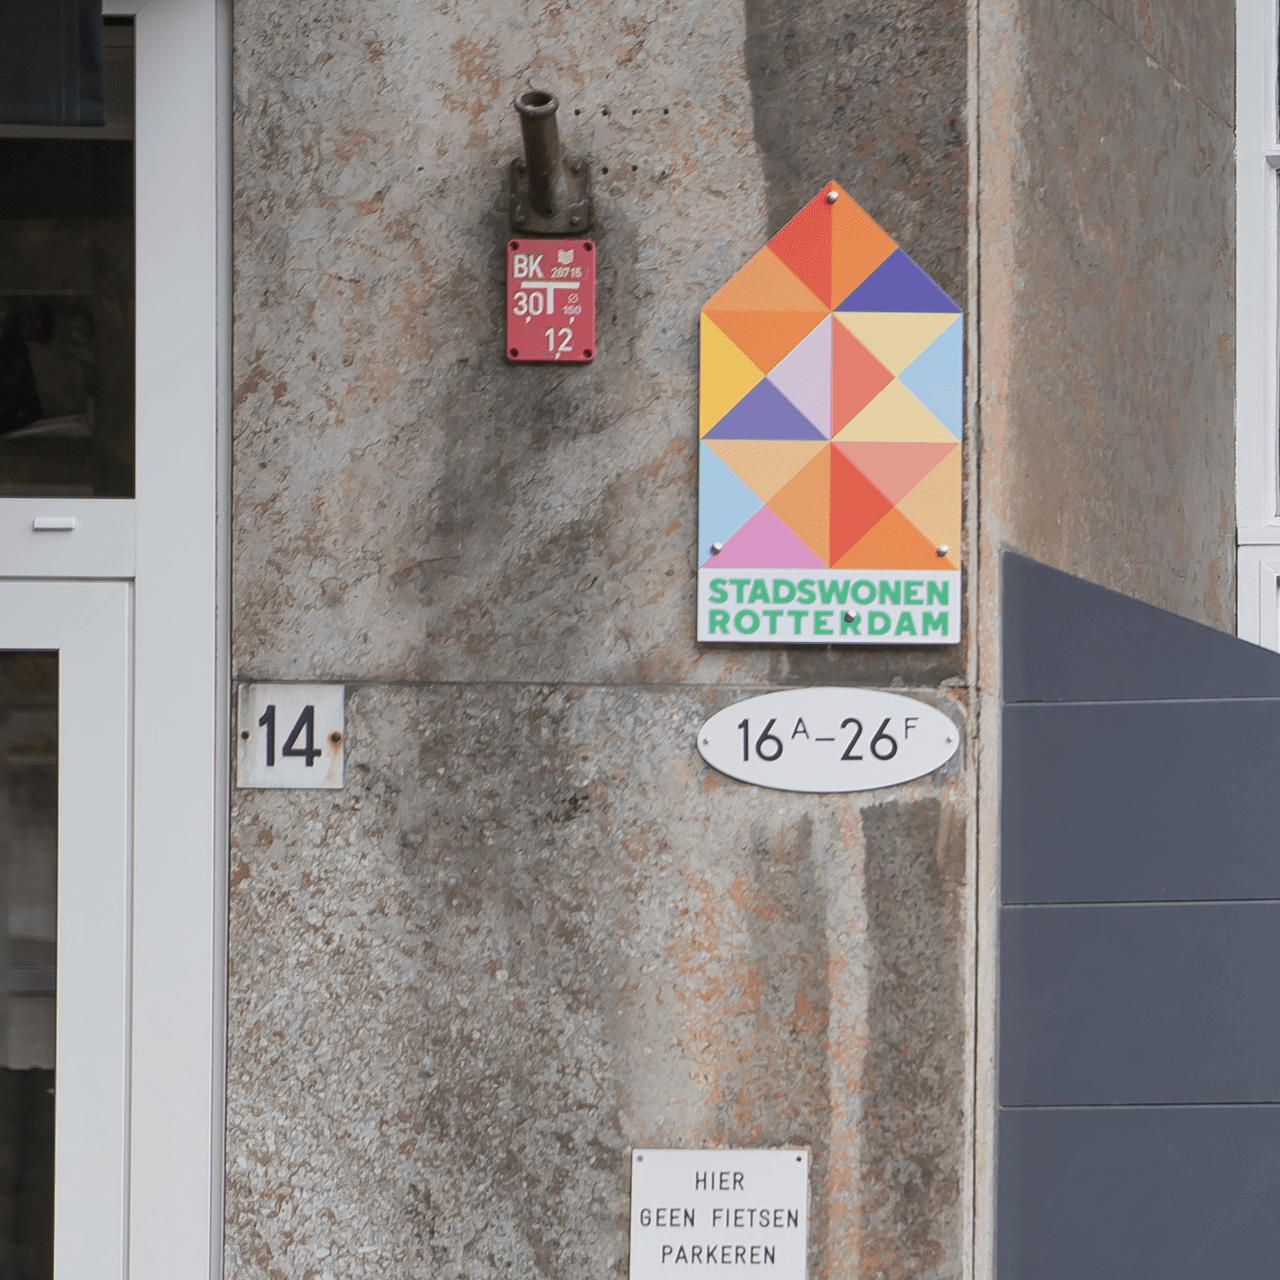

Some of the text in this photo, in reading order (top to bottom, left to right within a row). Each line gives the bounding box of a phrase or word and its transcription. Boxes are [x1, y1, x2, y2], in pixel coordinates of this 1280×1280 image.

[513, 253, 544, 279] BK
[708, 578, 949, 606] STADSWONEN
[708, 609, 949, 637] ROTTERDAM
[258, 704, 322, 767] 14
[695, 1171, 745, 1191] HIER
[639, 1207, 799, 1228] GEEN FIETSEN
[661, 1244, 776, 1265] PARKEREN
